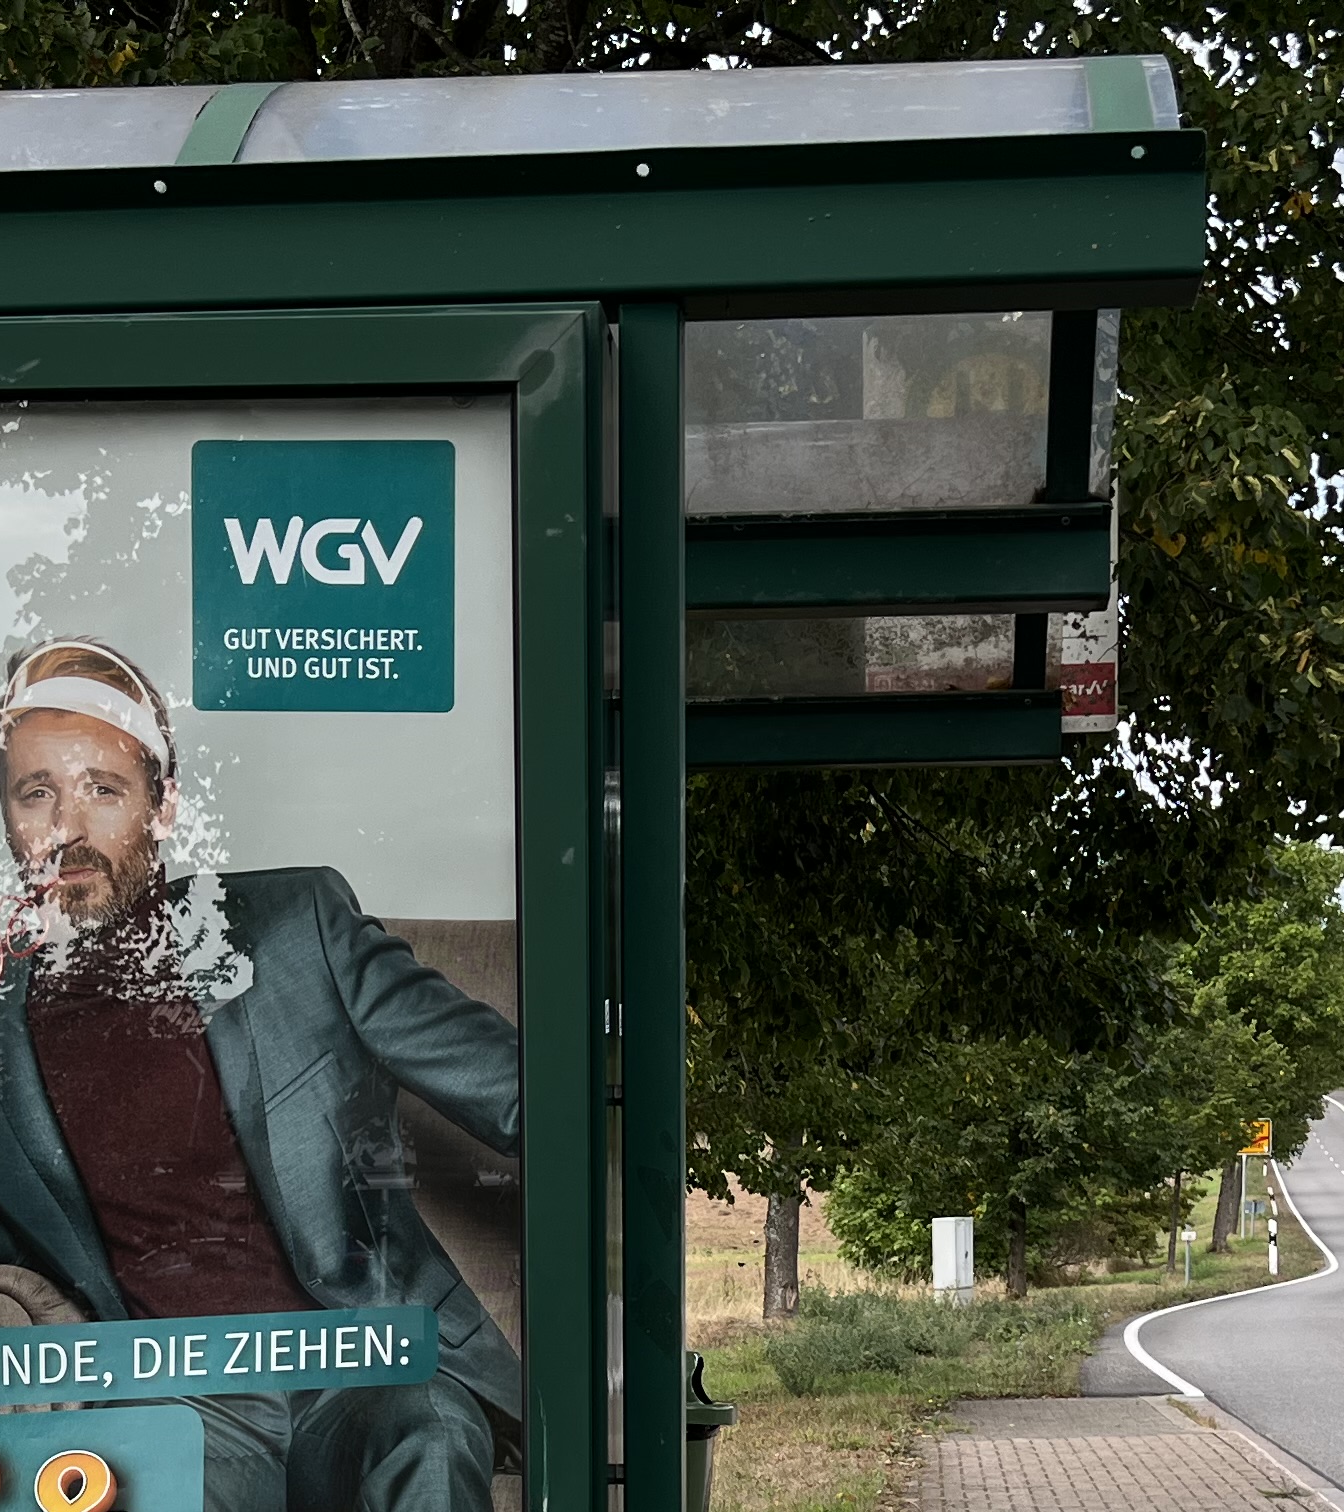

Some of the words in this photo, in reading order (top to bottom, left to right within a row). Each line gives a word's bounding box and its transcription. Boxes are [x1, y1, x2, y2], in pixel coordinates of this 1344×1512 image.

[223, 515, 424, 586] WGV
[223, 628, 271, 650] GUT
[275, 628, 423, 651] VERSICHERT.
[247, 657, 297, 679] UND
[304, 657, 352, 679] GUT
[357, 657, 399, 679] IST.
[132, 1333, 208, 1380] DIE
[223, 1323, 411, 1375] ZIEHEN:
